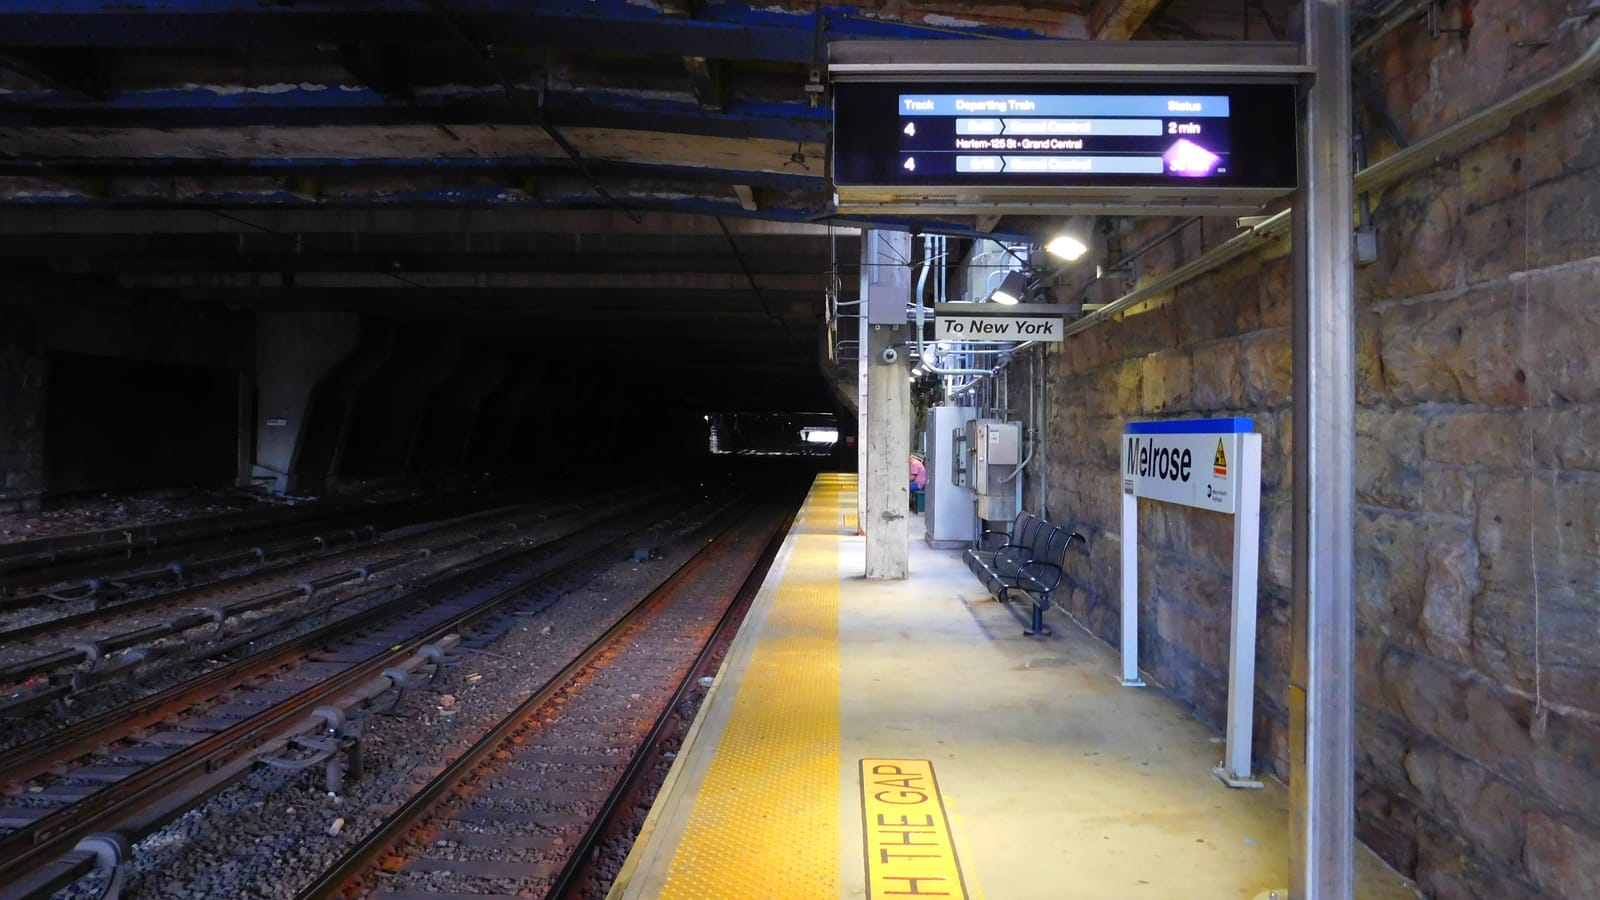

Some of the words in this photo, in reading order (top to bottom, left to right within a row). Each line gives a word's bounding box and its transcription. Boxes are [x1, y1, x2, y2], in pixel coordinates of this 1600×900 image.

[904, 99, 935, 111] Track
[956, 99, 1007, 113] Departing
[1008, 99, 1035, 111] Train
[1167, 100, 1202, 112] Status
[904, 122, 916, 136] 4
[1168, 121, 1178, 134] 2
[1178, 122, 1201, 134] min
[1022, 138, 1050, 149] Grand
[1050, 138, 1083, 149] Central
[904, 157, 916, 171] 4
[944, 319, 964, 335] To
[969, 319, 1009, 335] New
[1015, 319, 1056, 335] York
[1127, 437, 1192, 482] Melrose
[872, 764, 929, 805] GAP
[877, 813, 942, 864] THE
